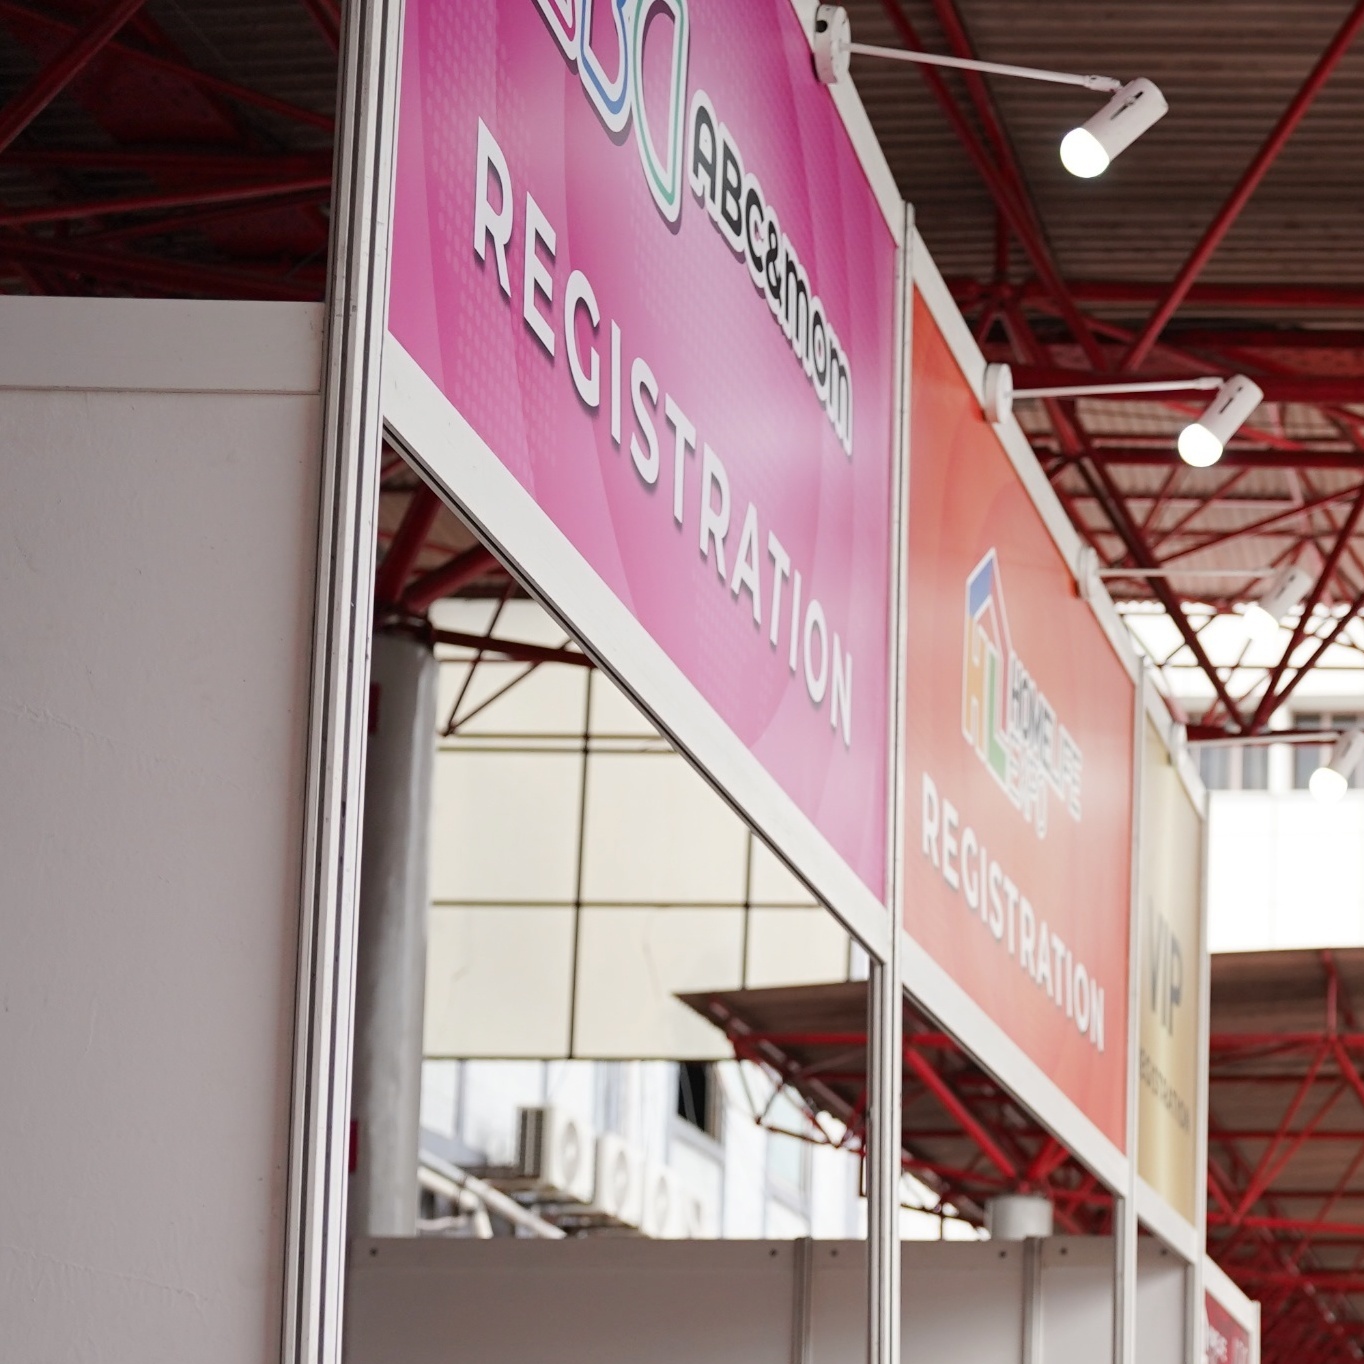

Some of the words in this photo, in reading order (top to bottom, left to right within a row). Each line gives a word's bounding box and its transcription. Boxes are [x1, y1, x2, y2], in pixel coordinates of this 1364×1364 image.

[473, 116, 853, 747] REGISTRATION
[922, 771, 1105, 1053] REGISTRATION
[1148, 894, 1184, 1037] VIP
